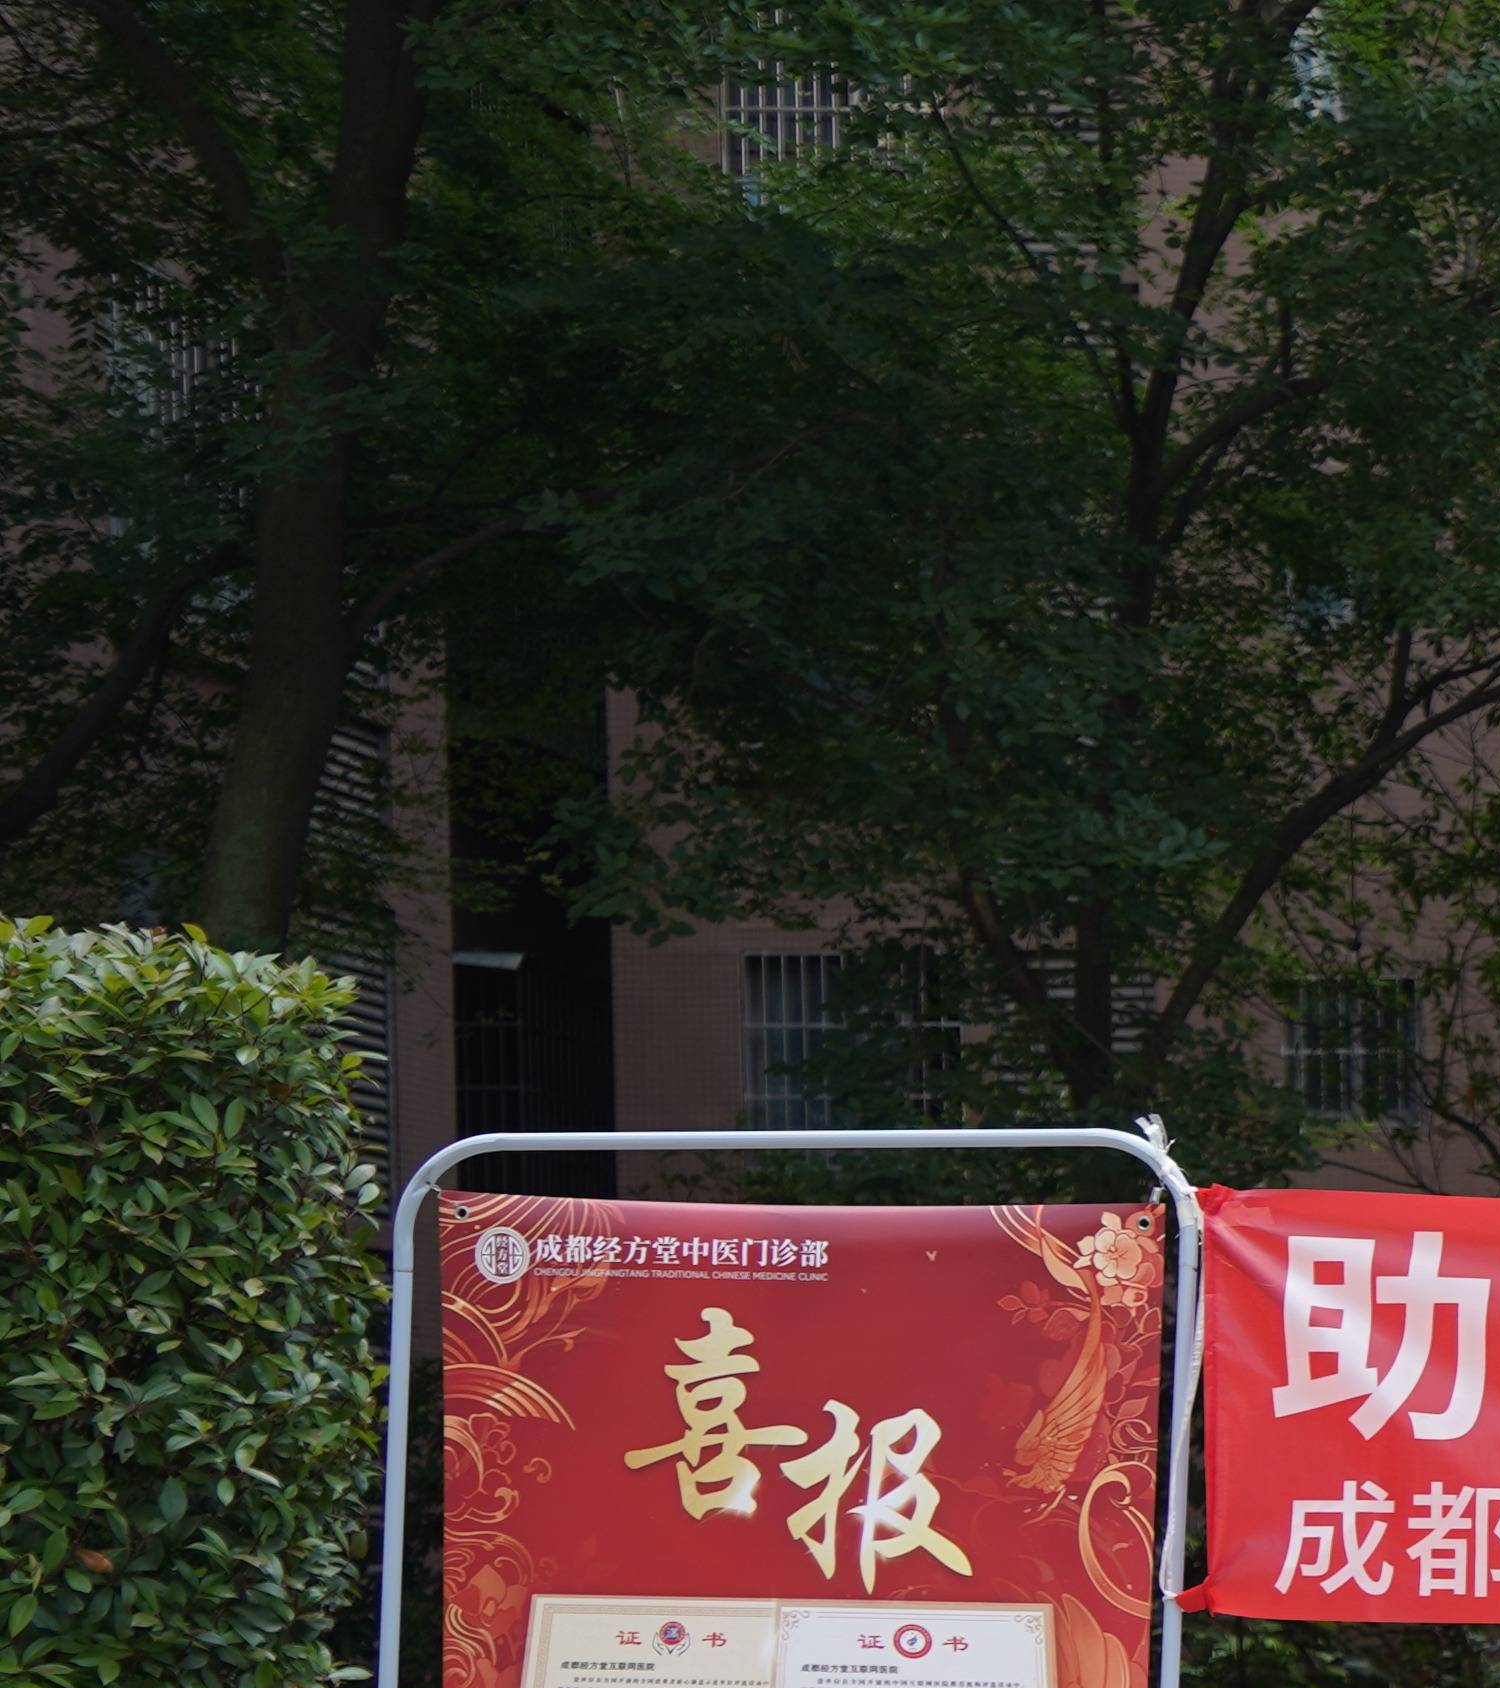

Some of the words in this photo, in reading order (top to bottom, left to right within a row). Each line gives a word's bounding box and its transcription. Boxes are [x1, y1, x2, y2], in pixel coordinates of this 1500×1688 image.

[536, 1235, 829, 1268] 成都经方堂中医门诊部
[651, 1271, 709, 1279] TRADITIONAL
[753, 1272, 796, 1280] MEDICINE
[624, 1306, 974, 1595] 喜报
[616, 1631, 642, 1646] 证
[702, 1632, 727, 1648] 书
[857, 1635, 885, 1649] 证
[943, 1636, 969, 1651] 书
